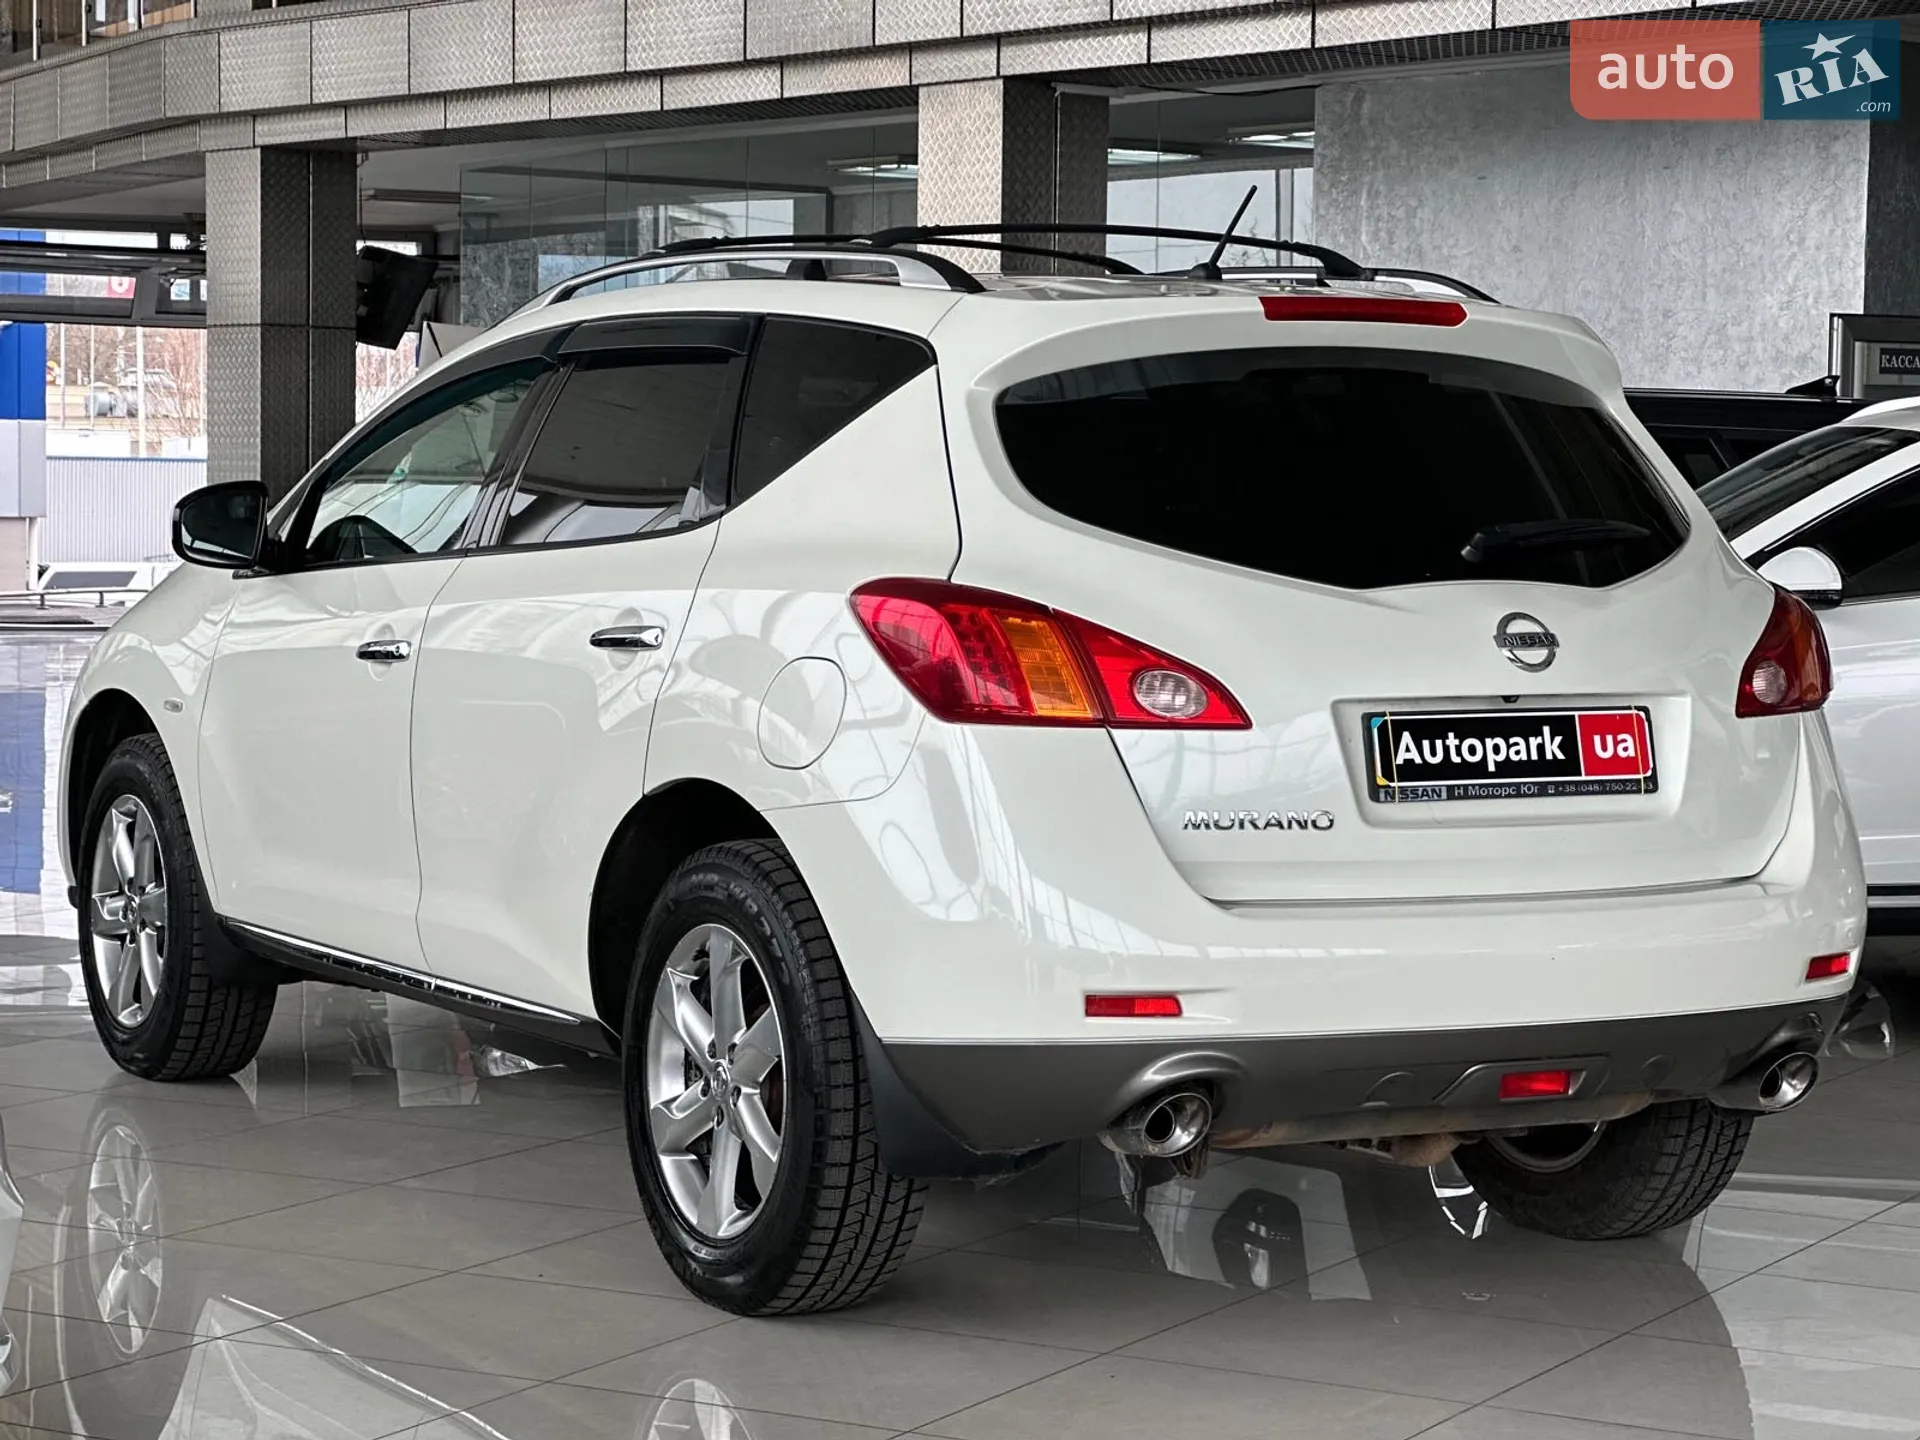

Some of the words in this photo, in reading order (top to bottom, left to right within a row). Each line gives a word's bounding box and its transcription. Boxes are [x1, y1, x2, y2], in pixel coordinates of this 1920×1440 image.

[1503, 635, 1556, 647] NISSAN
[1395, 726, 1566, 771] Autopark
[1593, 733, 1636, 759] ua
[1384, 787, 1442, 801] NSSAN
[1468, 786, 1517, 797] Моторс
[1520, 783, 1541, 795] Юг
[1558, 783, 1576, 793] +38
[1182, 809, 1335, 831] MURANO
